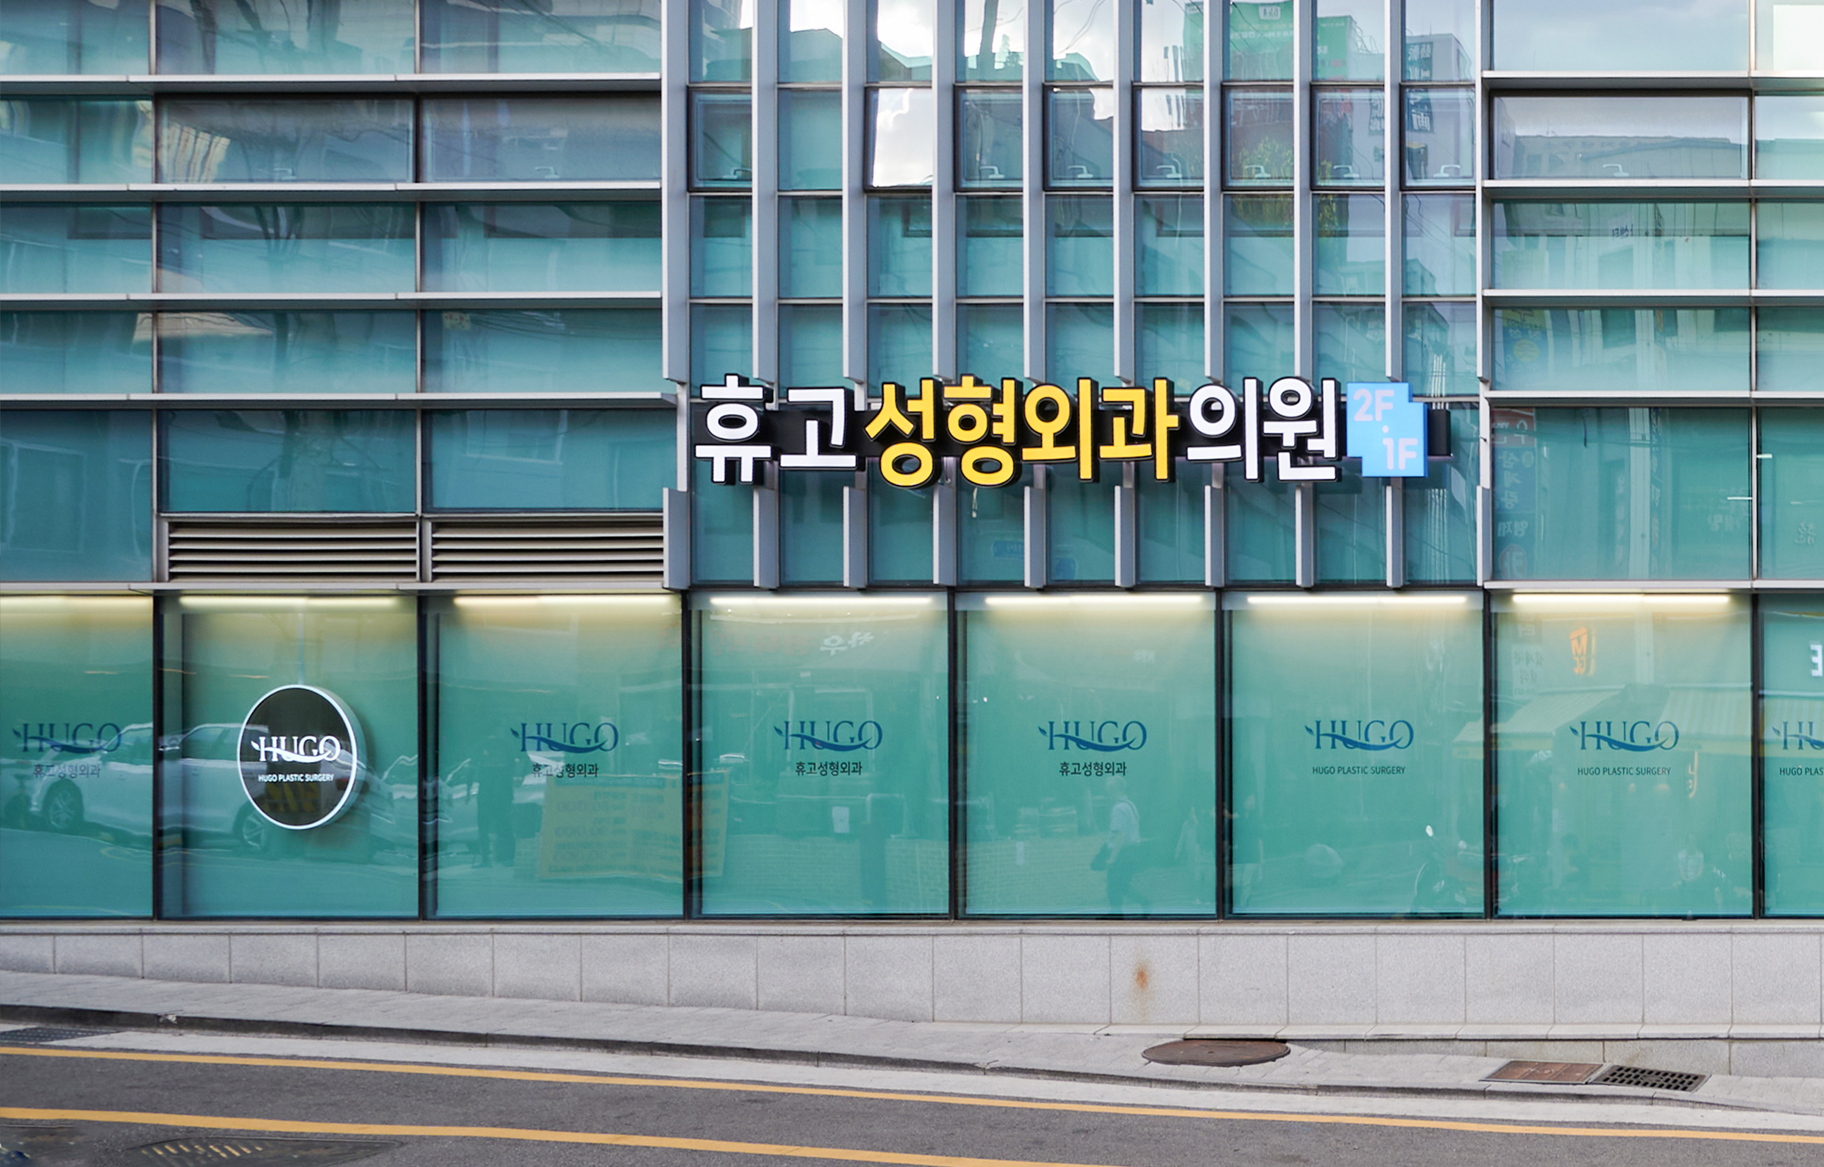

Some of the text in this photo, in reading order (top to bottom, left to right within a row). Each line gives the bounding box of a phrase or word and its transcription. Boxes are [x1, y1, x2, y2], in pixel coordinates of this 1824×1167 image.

[1352, 391, 1394, 423] 2F
[695, 374, 1339, 486] 휴고성형외과의원
[1381, 437, 1418, 468] 1F
[16, 723, 122, 753] HUGO
[252, 735, 341, 763] HUGO
[514, 722, 620, 753] HUGO
[779, 720, 883, 751] HUGO
[1043, 720, 1147, 752] HUGO
[1310, 719, 1414, 751] HUGO
[1575, 720, 1680, 751] HUGO
[258, 774, 334, 782] HUGO PLASTIC SURGERY
[532, 762, 599, 778] 휴고성형외과
[795, 761, 863, 776] 휴고성형외과
[1059, 761, 1128, 776] 휴고성형외과
[1312, 765, 1406, 776] HUGO PLASTIC SURGERY
[1577, 766, 1671, 776] HUGO PLASTIC SURGERY
[1780, 766, 1803, 776] HUGO
